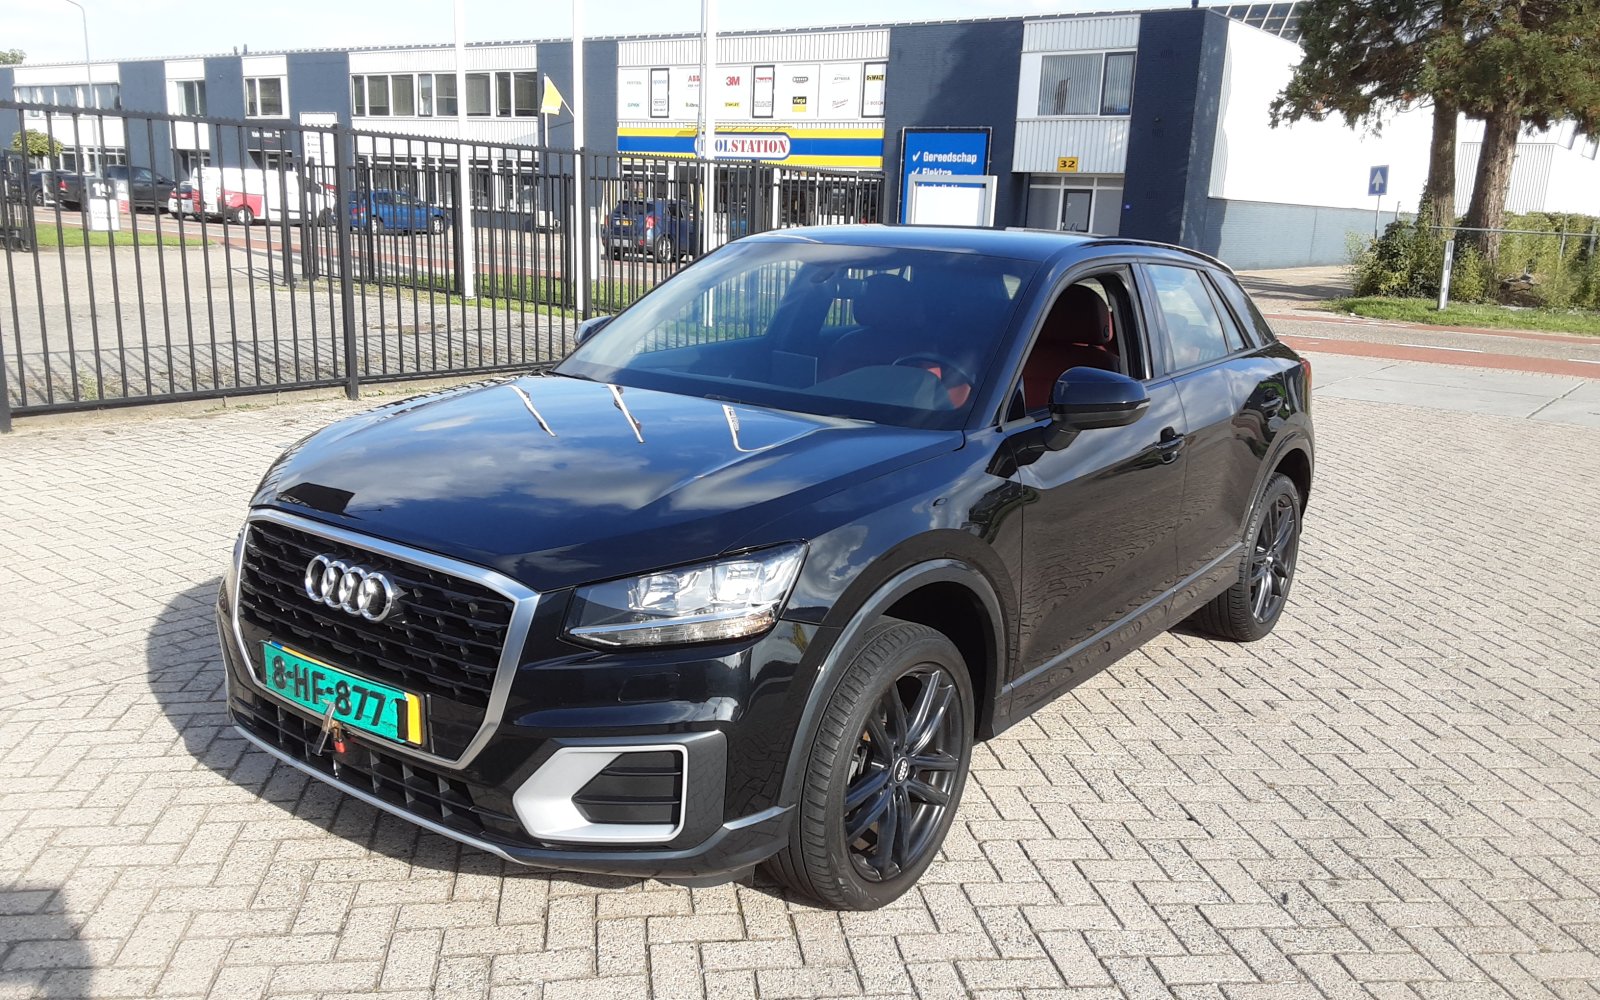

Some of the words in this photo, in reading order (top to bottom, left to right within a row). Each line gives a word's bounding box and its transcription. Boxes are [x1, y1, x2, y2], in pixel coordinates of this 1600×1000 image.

[725, 76, 740, 86] 3M
[698, 139, 787, 154] TOLSTATION
[923, 151, 977, 165] Gereedschap
[1060, 160, 1075, 168] 32
[272, 655, 386, 726] 8-HF-877
